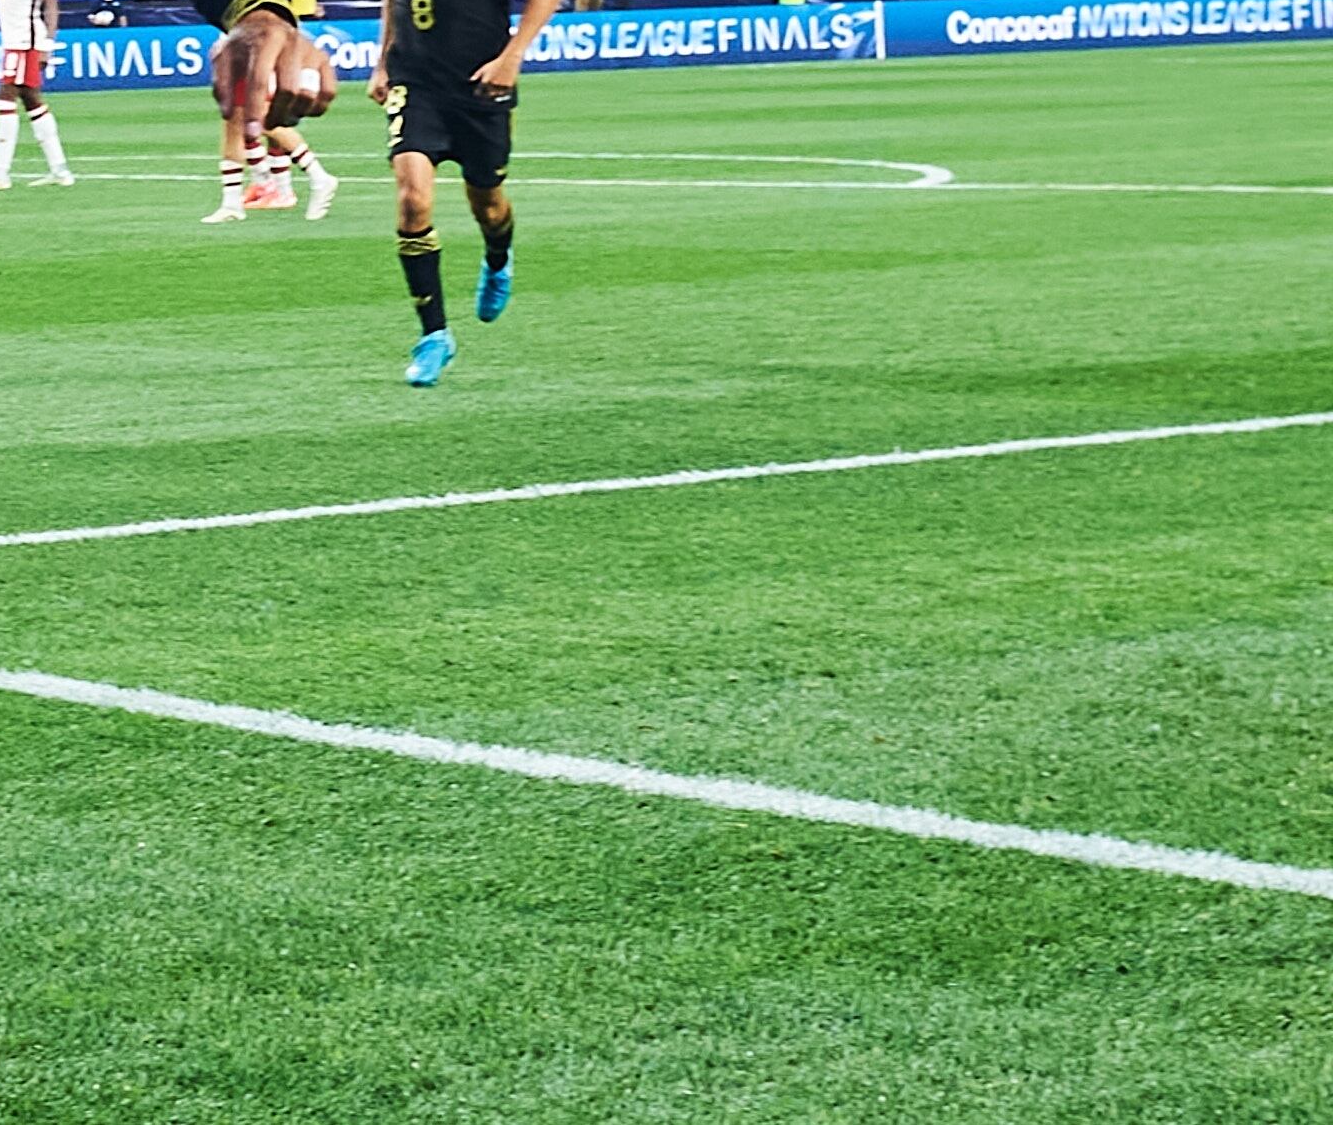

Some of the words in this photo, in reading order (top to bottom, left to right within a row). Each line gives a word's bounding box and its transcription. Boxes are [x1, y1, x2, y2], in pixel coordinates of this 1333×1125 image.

[599, 19, 718, 59] LEAGUE
[718, 12, 857, 54] FINALS
[946, 6, 1077, 44] Concacaf
[1078, 1, 1190, 39] NATIONS
[386, 84, 408, 115] 8
